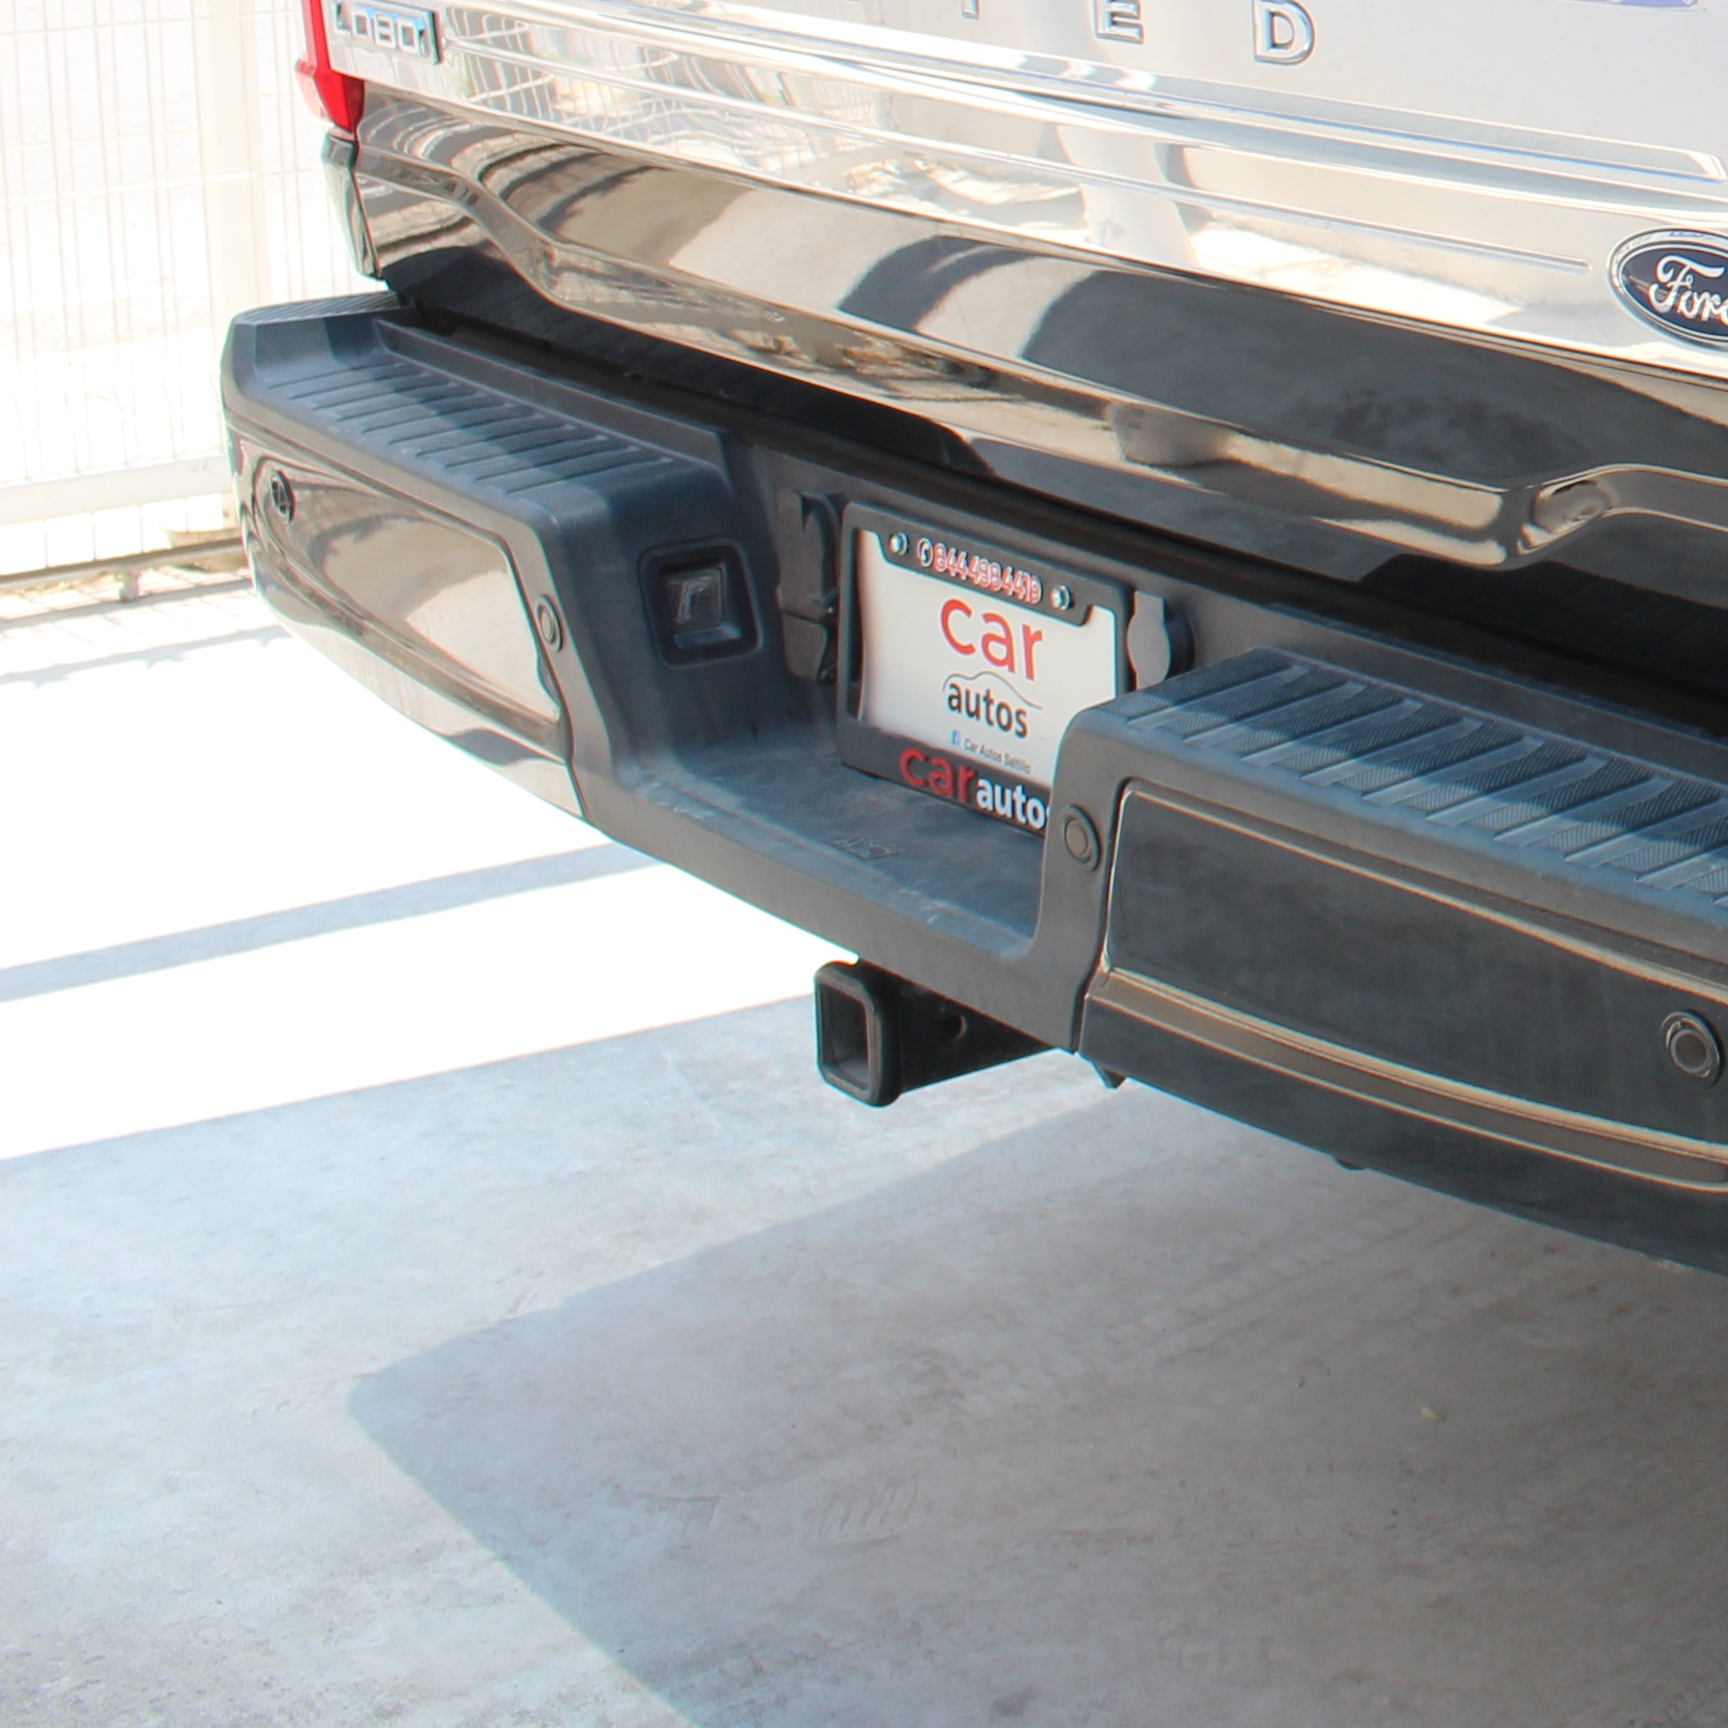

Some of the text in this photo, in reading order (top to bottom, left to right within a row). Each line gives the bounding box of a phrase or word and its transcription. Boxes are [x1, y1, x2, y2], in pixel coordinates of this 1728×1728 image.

[333, 0, 425, 56] LOBO
[941, 598, 1043, 681] car
[947, 683, 1028, 739] autos
[900, 748, 1050, 830] car auto
